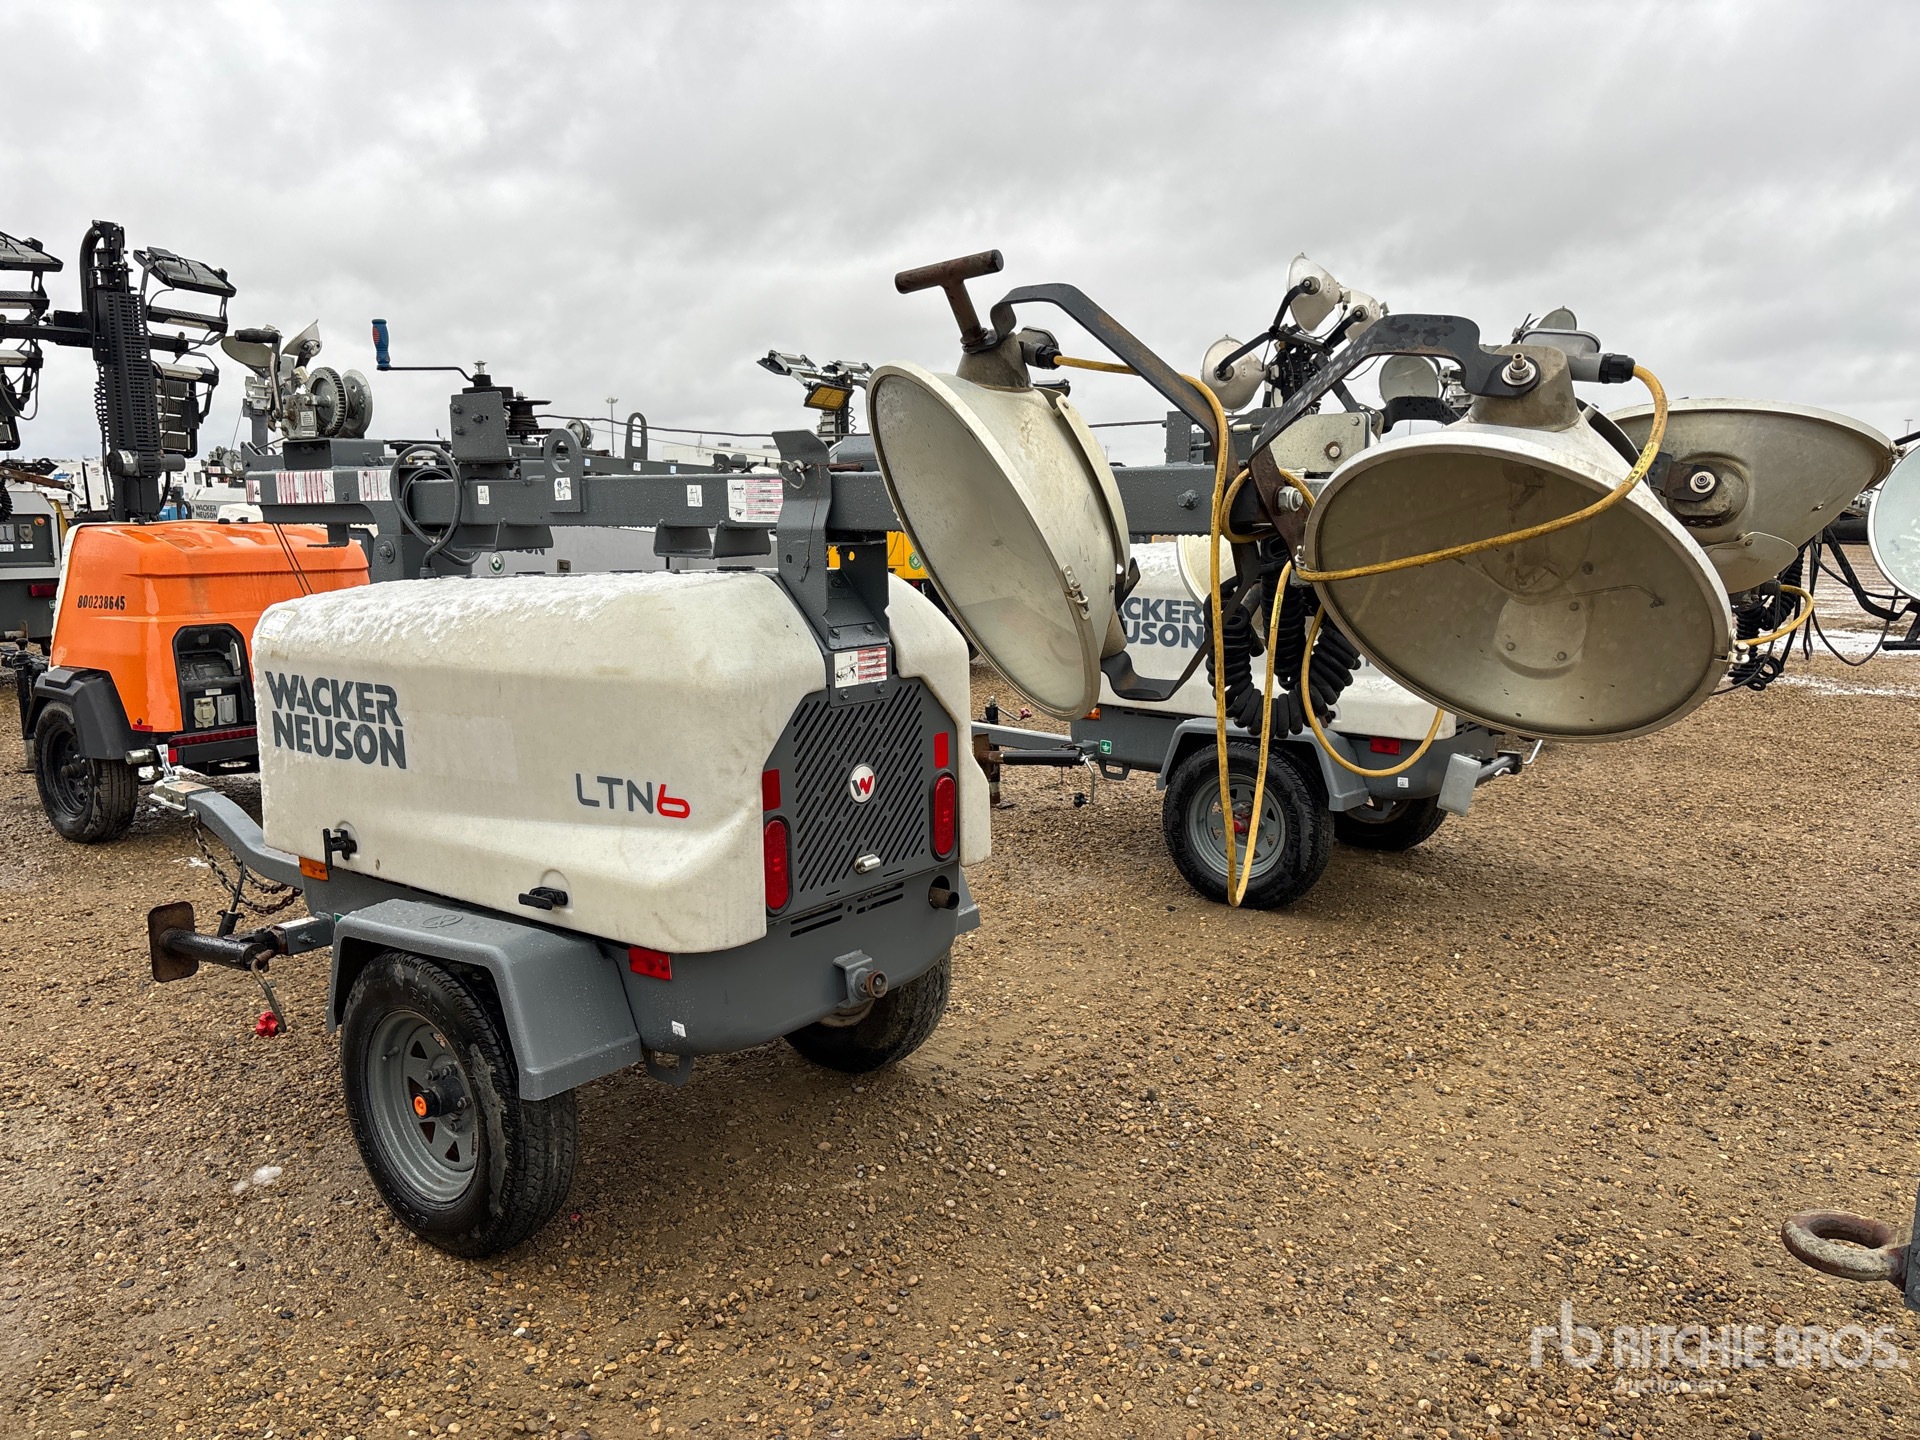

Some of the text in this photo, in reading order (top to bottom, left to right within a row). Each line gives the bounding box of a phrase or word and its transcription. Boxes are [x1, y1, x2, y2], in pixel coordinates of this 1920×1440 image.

[77, 594, 126, 611] 800238645
[1118, 597, 1204, 625] CKER
[1125, 620, 1204, 649] USON
[265, 671, 403, 727] WACKER
[272, 711, 407, 769] NEUSON
[576, 773, 691, 819] LTN6
